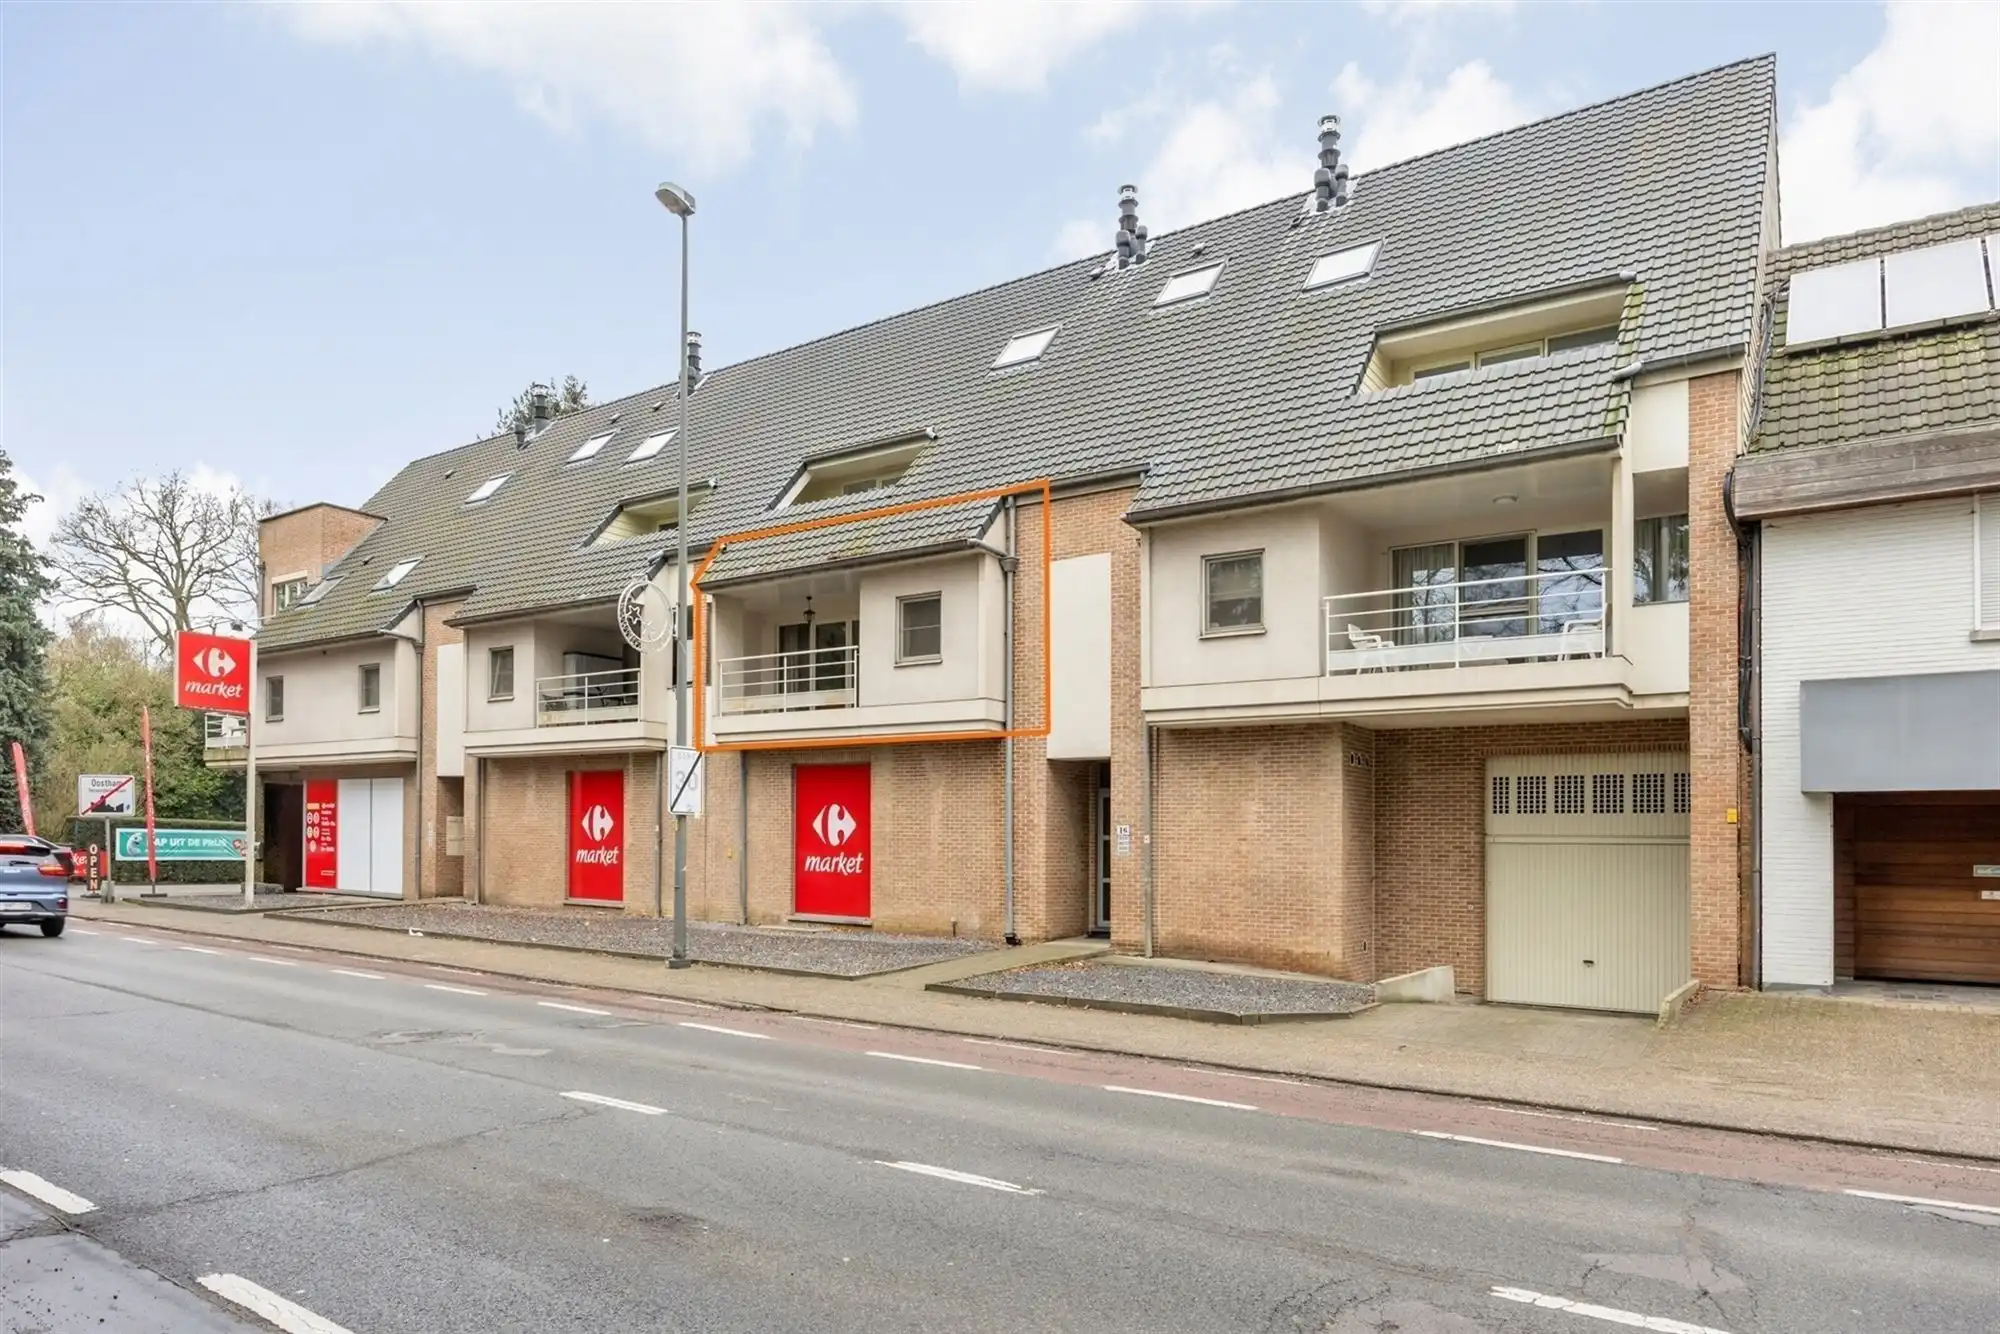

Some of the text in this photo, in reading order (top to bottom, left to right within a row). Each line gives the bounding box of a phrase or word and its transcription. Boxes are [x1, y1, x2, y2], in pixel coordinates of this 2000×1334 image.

[184, 680, 243, 699] market
[89, 843, 98, 890] OPEN
[575, 845, 620, 867] market
[804, 851, 864, 876] market
